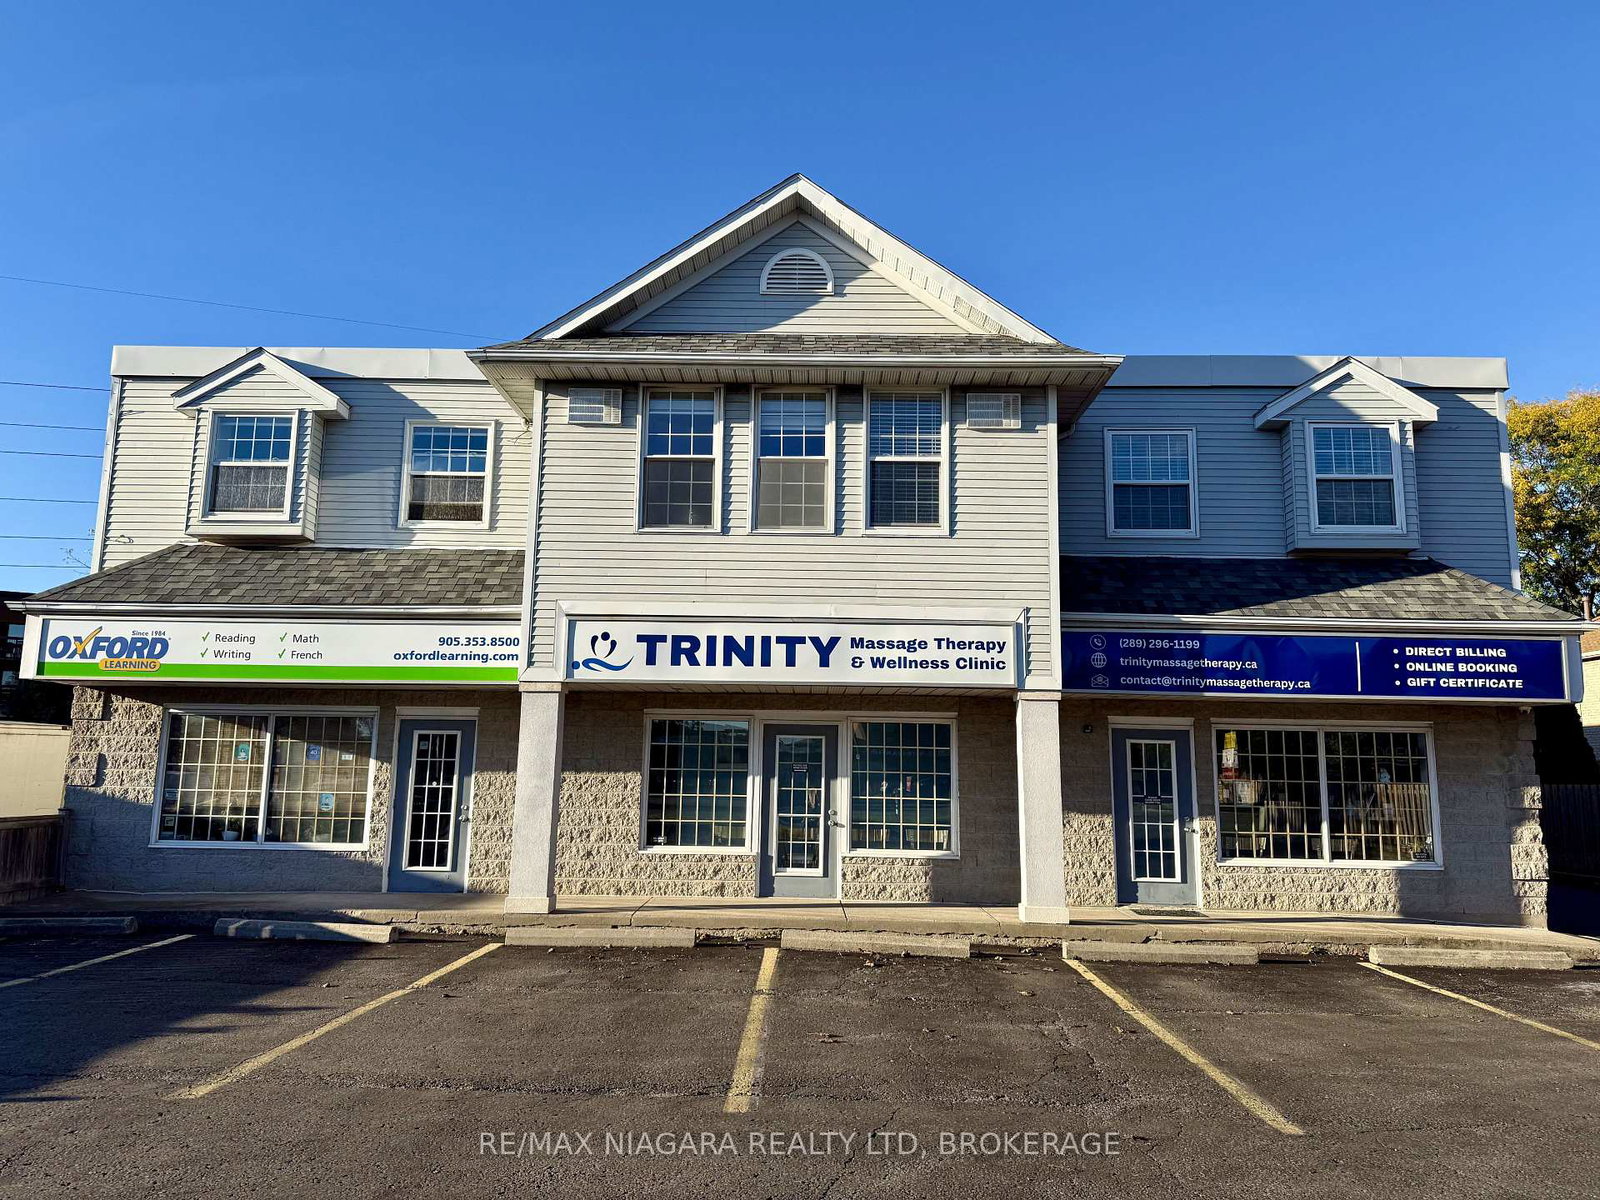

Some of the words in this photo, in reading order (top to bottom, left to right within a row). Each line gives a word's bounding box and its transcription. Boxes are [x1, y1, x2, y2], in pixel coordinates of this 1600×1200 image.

[214, 633, 256, 645] Reading
[292, 634, 319, 644] Math
[438, 636, 520, 647] 905.353.8500
[850, 637, 929, 652] Massage
[933, 637, 1007, 653] Therapy
[1119, 638, 1147, 649] (289)
[1148, 638, 1200, 650] 296-1199
[48, 632, 169, 660] OXFORD
[636, 633, 841, 668] TRINITY
[213, 648, 252, 661] Writing
[290, 649, 323, 660] French
[393, 650, 519, 663] oxfordlearning.com
[1405, 647, 1452, 656] DIRECT
[1456, 648, 1506, 658] BILLING
[104, 661, 158, 670] LEARNING
[851, 656, 865, 669] &
[870, 656, 951, 670] Wellness
[955, 657, 1006, 671] Clinic
[1120, 656, 1258, 670] trinitymassagetherapy.ca
[1406, 662, 1455, 672] ONLINE
[1458, 664, 1518, 673] BOOKING
[1120, 674, 1311, 690] contact@trinitymassagetherapy.ca
[1407, 678, 1436, 687] GIFT
[1439, 678, 1523, 688] CERTIFICATE
